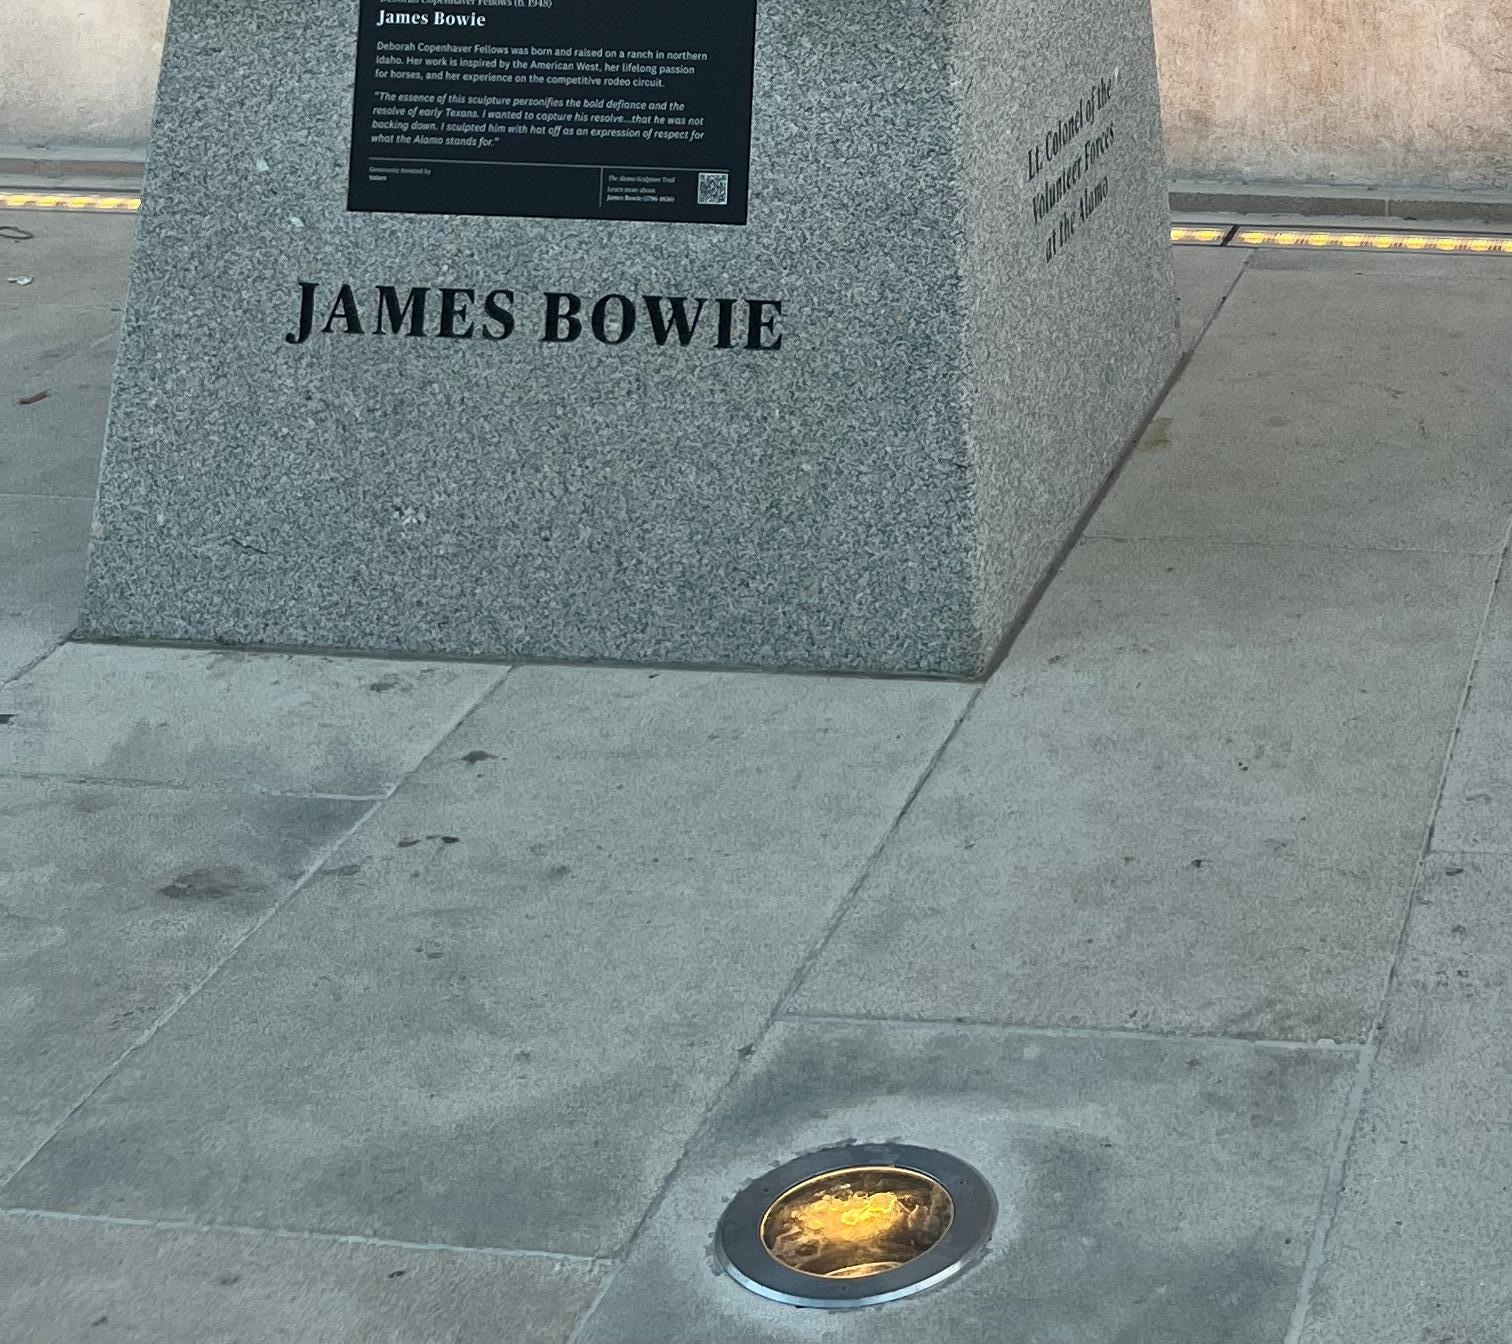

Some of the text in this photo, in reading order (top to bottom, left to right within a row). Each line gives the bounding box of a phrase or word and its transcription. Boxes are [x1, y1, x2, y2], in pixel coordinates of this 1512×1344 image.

[376, 9, 485, 26] James Bowie
[376, 40, 415, 51] Deborah
[417, 42, 472, 53] Copenhaver
[474, 44, 508, 54] Fellows
[530, 46, 552, 55] born
[554, 46, 572, 56] and
[574, 47, 602, 57] raised
[604, 50, 616, 58] on
[619, 50, 624, 58] a
[626, 49, 653, 58] ranch
[655, 50, 664, 58] in
[666, 50, 707, 60] northern
[375, 54, 694, 75] Idaho. Her work is inspired by the American West, her lifelong passion
[375, 68, 665, 87] for horses, and her experience on the competitive rodeo circuit.
[398, 93, 435, 102] essence
[436, 92, 447, 105] of
[448, 94, 466, 103] this
[468, 95, 511, 106] sculpture
[513, 95, 564, 108] personifies
[566, 98, 581, 107] the
[583, 98, 604, 108] bold
[606, 98, 647, 111] defiance
[648, 100, 667, 110] and
[669, 101, 685, 110] the
[373, 105, 406, 115] resolve
[407, 105, 418, 118] of
[418, 106, 443, 118] early
[444, 107, 480, 118] Texans.
[481, 109, 486, 118] I
[488, 110, 522, 119] wanted
[524, 111, 534, 120] to
[536, 112, 572, 122] capture
[574, 111, 589, 121] his
[654, 115, 666, 124] he
[667, 116, 686, 124] was
[688, 117, 704, 125] not
[1045, 98, 1084, 162] Colonel
[1085, 85, 1096, 125] of
[1097, 77, 1111, 111] the
[371, 119, 410, 131] backing
[411, 120, 439, 130] down.
[440, 121, 445, 130] I
[446, 122, 486, 133] sculpted
[488, 122, 506, 132] him
[508, 124, 528, 133] with
[530, 124, 546, 134] hat
[548, 124, 561, 136] off
[563, 127, 574, 135] as
[590, 128, 640, 138] expression
[642, 127, 652, 140] of
[654, 130, 688, 140] respect
[690, 129, 704, 141] for
[371, 133, 394, 142] what
[396, 134, 412, 143] the
[413, 134, 444, 144] Alamo
[446, 135, 477, 146] stands
[1033, 120, 1114, 225] Volunteer Forces
[1046, 175, 1109, 263] at the Alamo
[285, 281, 784, 351] JAMES BOWIE
